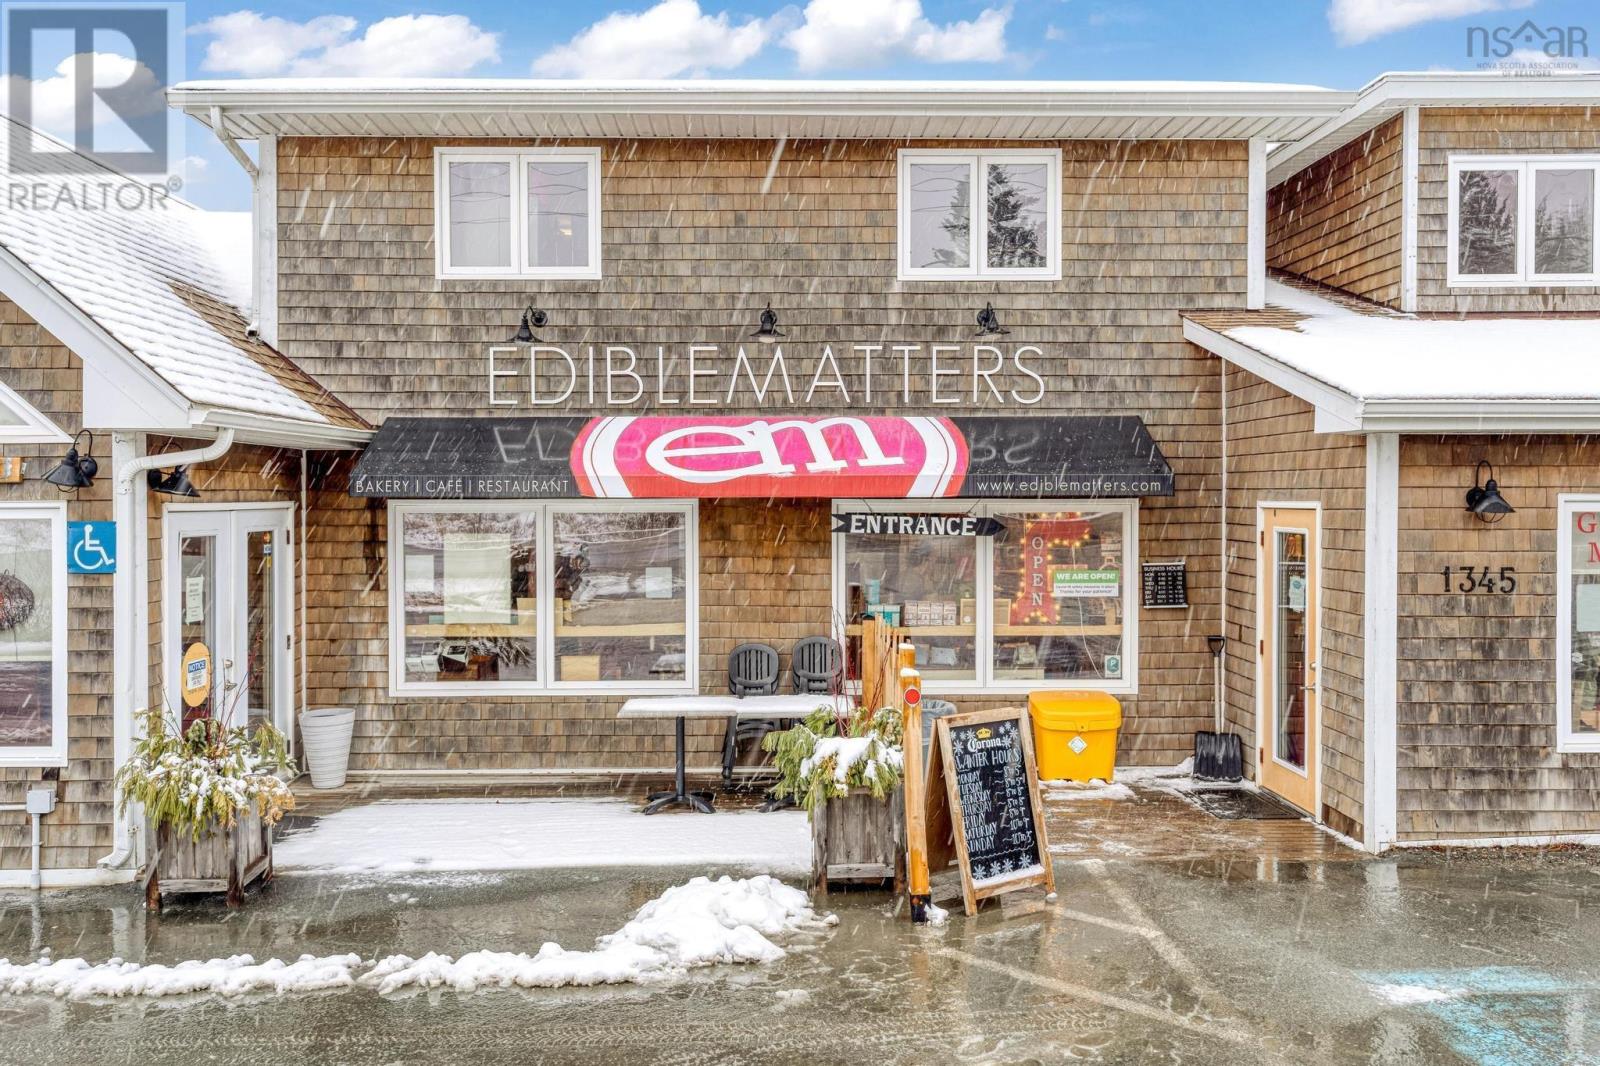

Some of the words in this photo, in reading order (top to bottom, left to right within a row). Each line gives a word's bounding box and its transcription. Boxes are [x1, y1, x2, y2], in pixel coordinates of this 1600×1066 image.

[355, 480, 410, 494] BAKERY
[478, 479, 570, 494] RESTAURANT
[976, 476, 1162, 492] www.ediblematters.com
[850, 514, 978, 536] ENTRANCE
[1031, 536, 1045, 607] OPEN
[1440, 566, 1516, 594] 1345
[967, 737, 1002, 753] Corona
